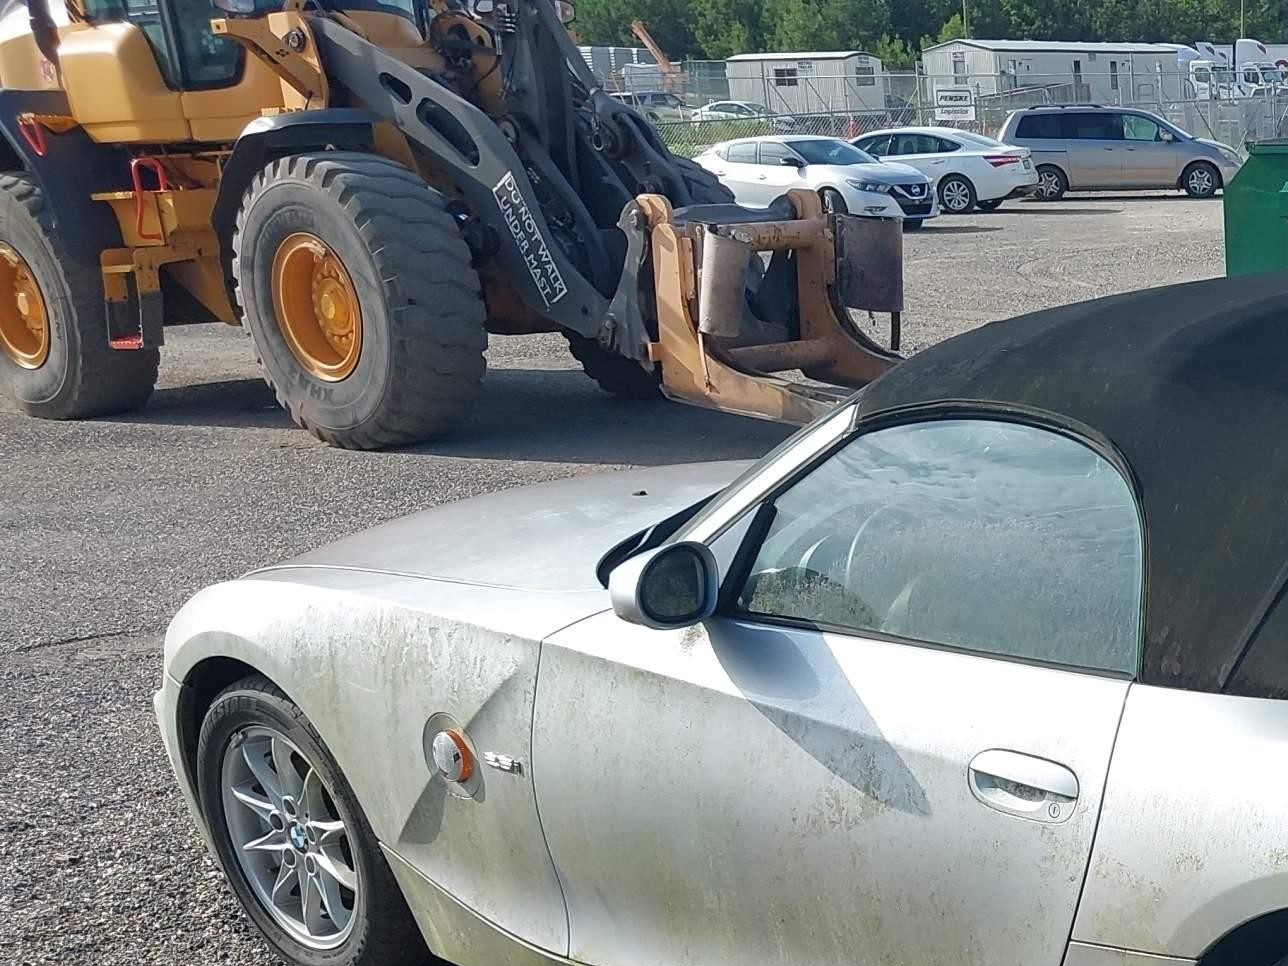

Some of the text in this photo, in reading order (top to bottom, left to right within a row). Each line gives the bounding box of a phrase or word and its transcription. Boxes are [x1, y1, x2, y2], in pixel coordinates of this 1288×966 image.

[500, 196, 552, 295] UNDER MAST
[504, 177, 564, 294] DO NOT WALK
